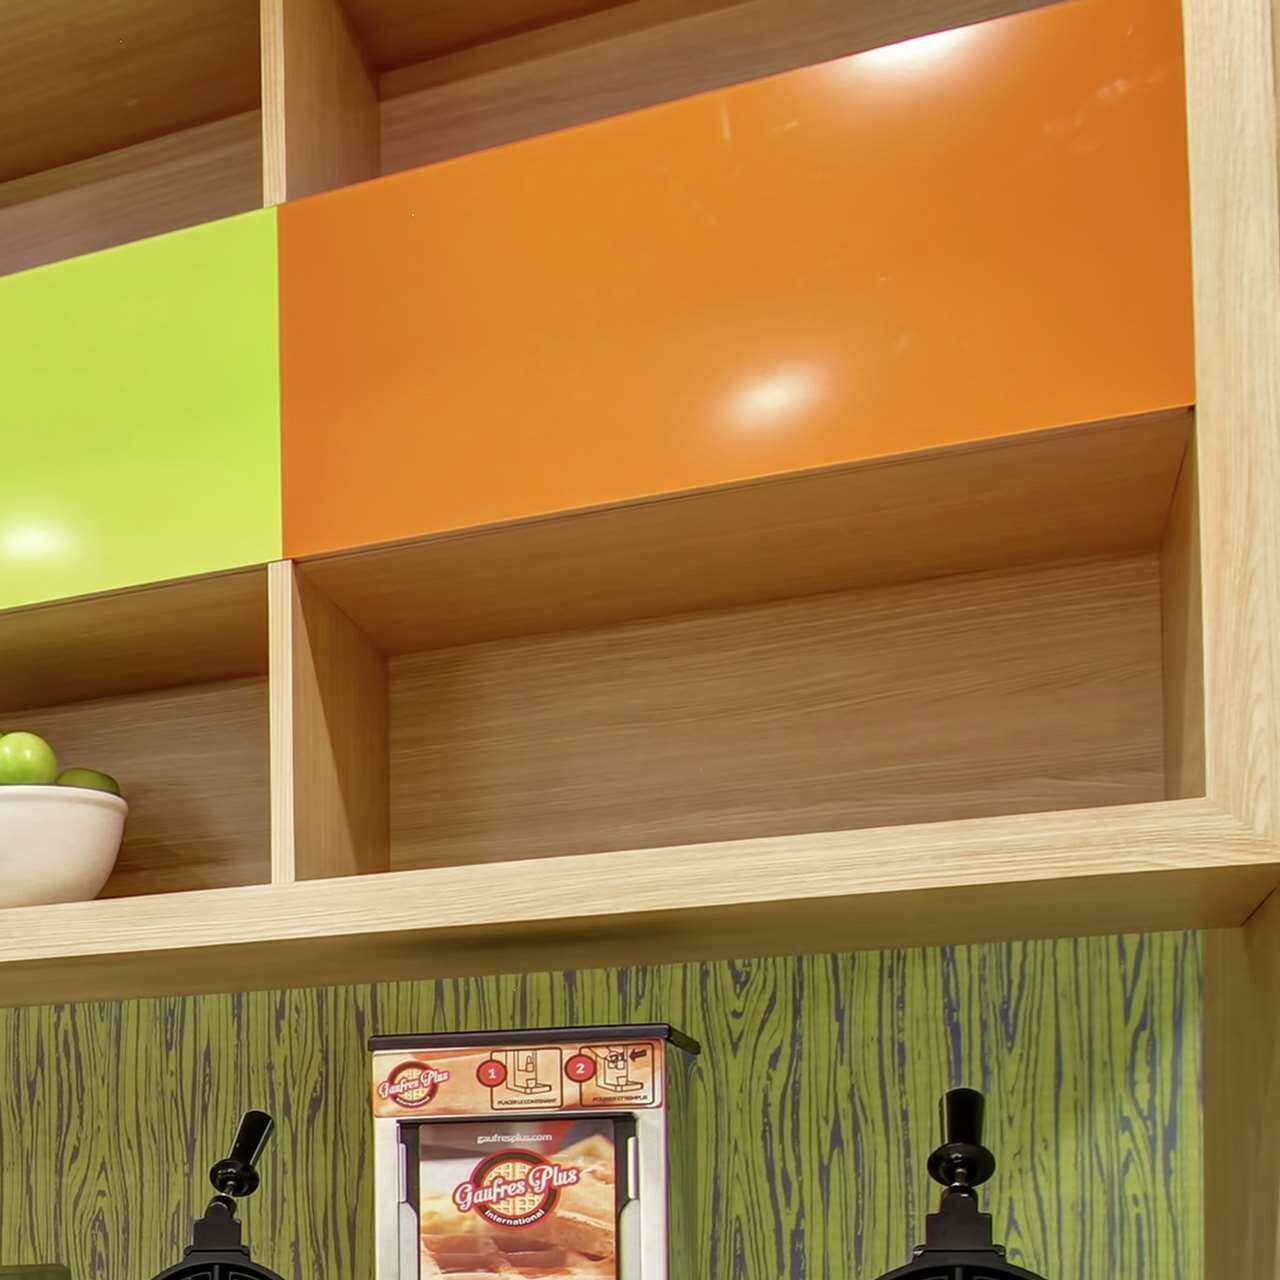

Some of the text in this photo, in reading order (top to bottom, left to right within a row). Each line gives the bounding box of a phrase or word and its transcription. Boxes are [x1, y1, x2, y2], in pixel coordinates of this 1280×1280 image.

[488, 1068, 496, 1079] 1
[576, 1063, 584, 1074] 2
[477, 1133, 552, 1145] gaufresplus.com
[455, 1165, 578, 1211] Gaufres Plus
